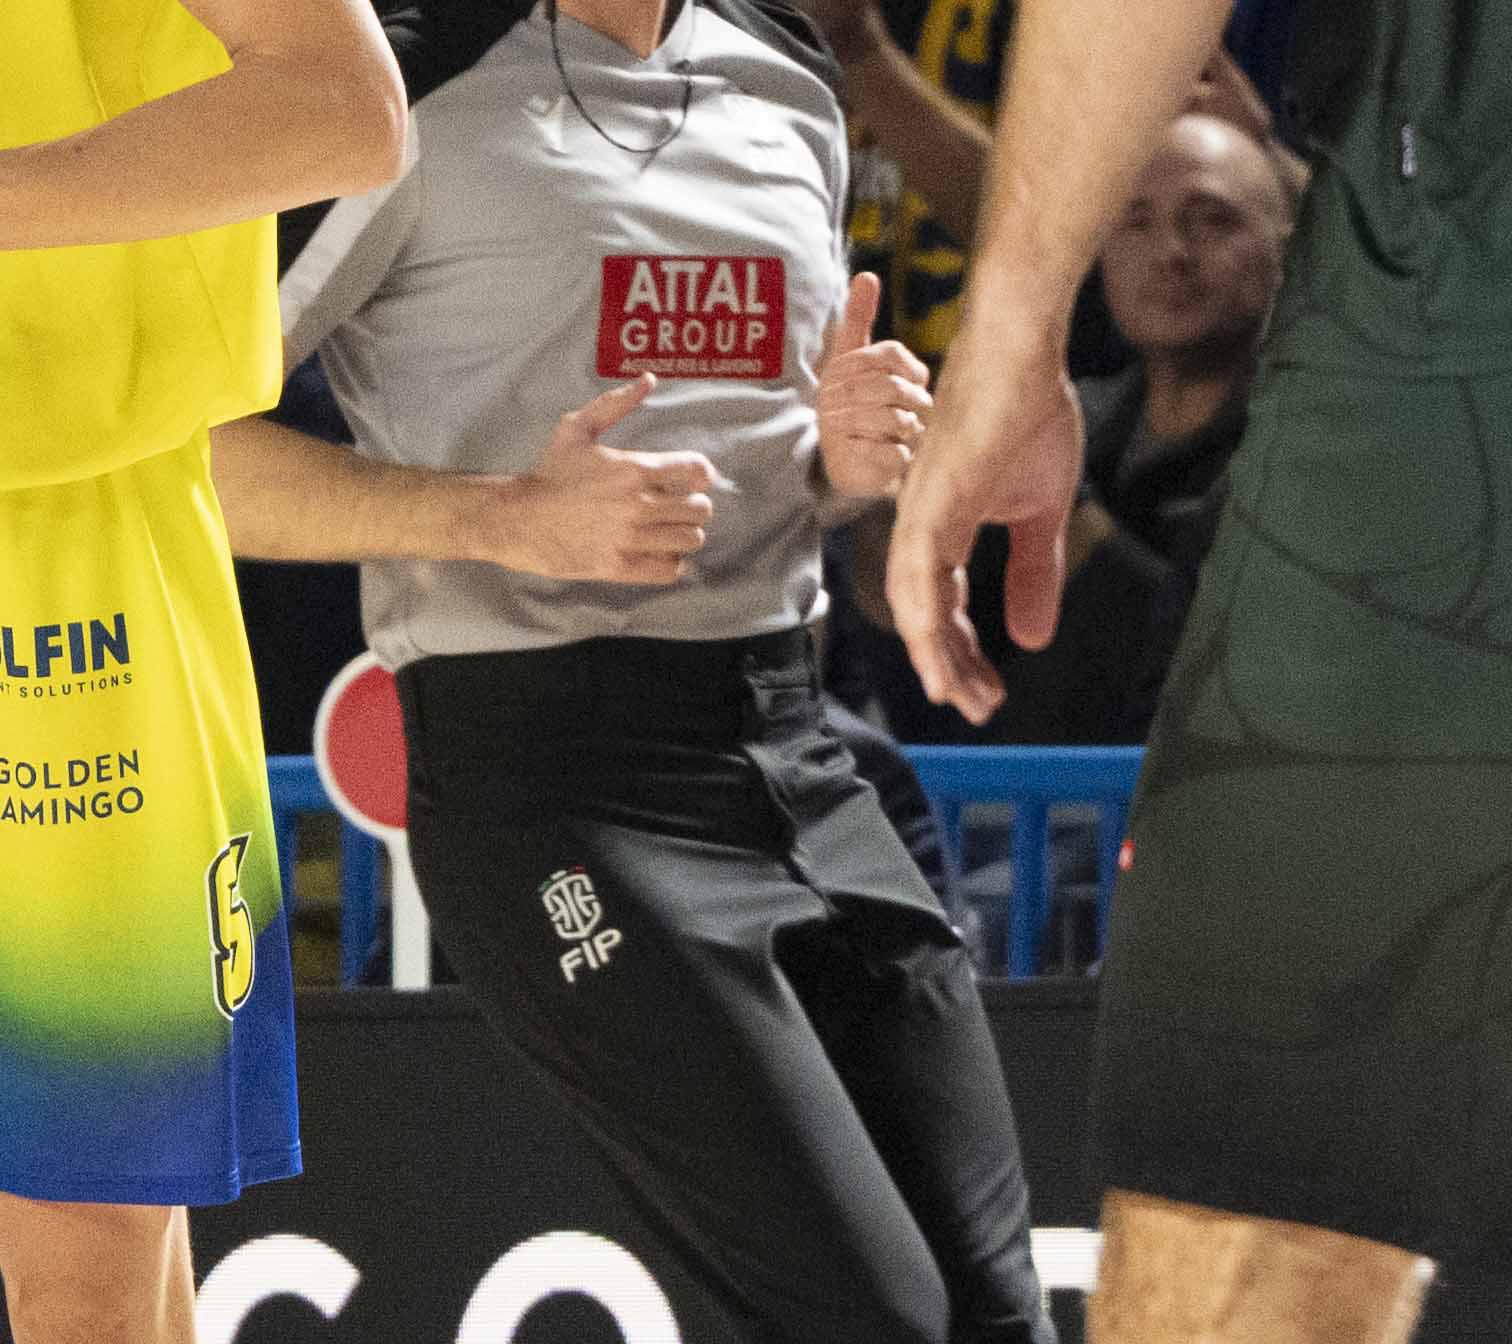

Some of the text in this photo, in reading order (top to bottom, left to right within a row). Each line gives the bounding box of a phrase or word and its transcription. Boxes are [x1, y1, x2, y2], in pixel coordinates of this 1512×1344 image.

[624, 260, 769, 315] ATTAL
[621, 319, 767, 353] GROUP
[20, 672, 133, 698] SOLUTIONS
[205, 831, 253, 1022] 5
[560, 928, 623, 983] FIP
